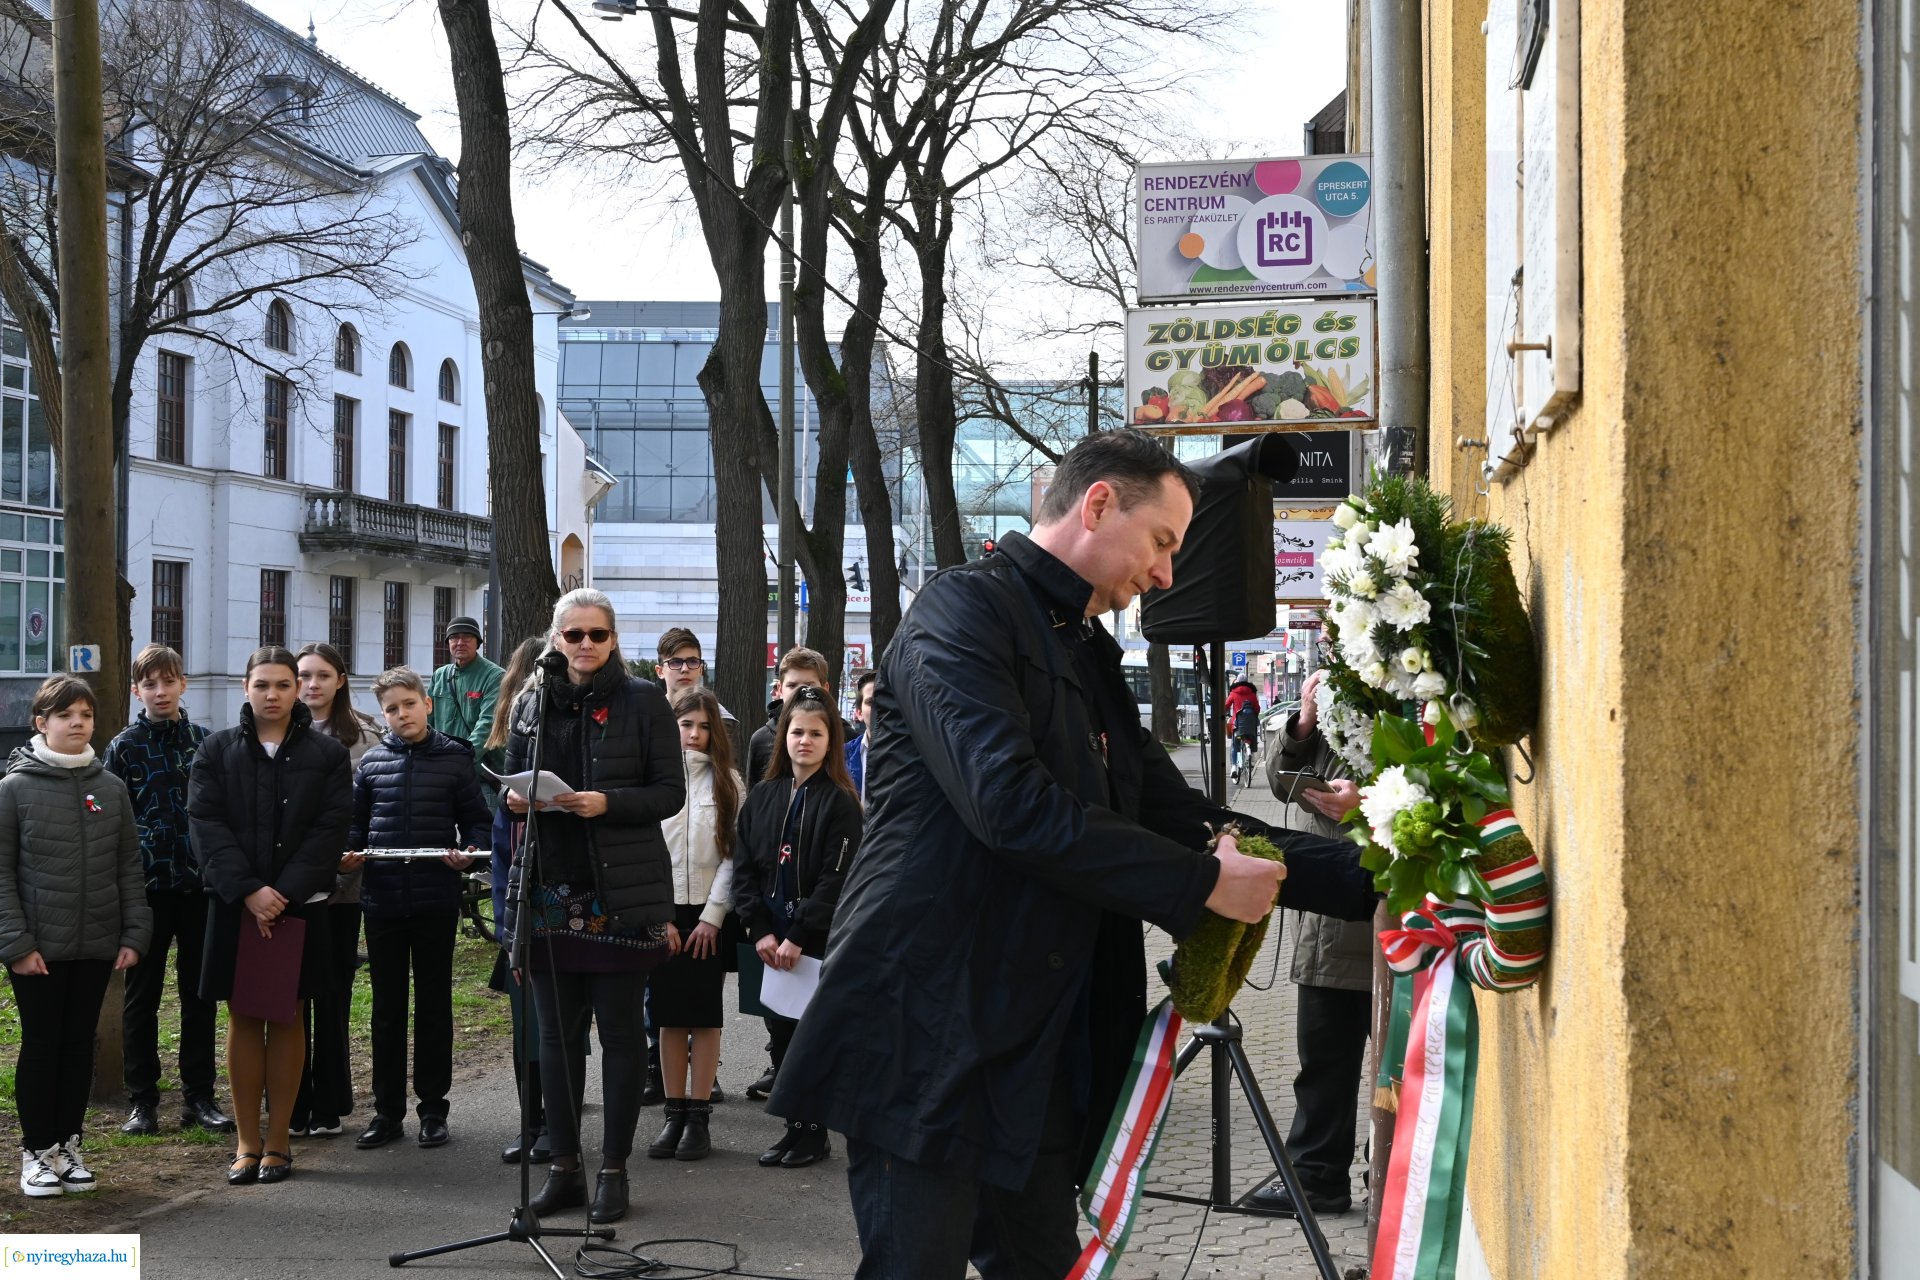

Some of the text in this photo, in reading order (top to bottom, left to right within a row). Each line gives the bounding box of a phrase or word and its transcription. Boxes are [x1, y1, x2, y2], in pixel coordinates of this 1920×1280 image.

[1144, 171, 1252, 191] RENDEZVÉNY
[1318, 180, 1368, 191] EPRESKERT
[1144, 195, 1226, 212] CENTRUM
[1351, 193, 1359, 201] 5.
[1144, 213, 1239, 225] ÉS PARTY SZAKÜZLET
[1268, 233, 1301, 252] RC
[1189, 281, 1327, 294] www.rendezvenycentrum.com
[1144, 310, 1358, 346] ZÖLDSÉG és
[1145, 336, 1361, 372] GYÜMÖLCS
[1299, 451, 1333, 467] NITA
